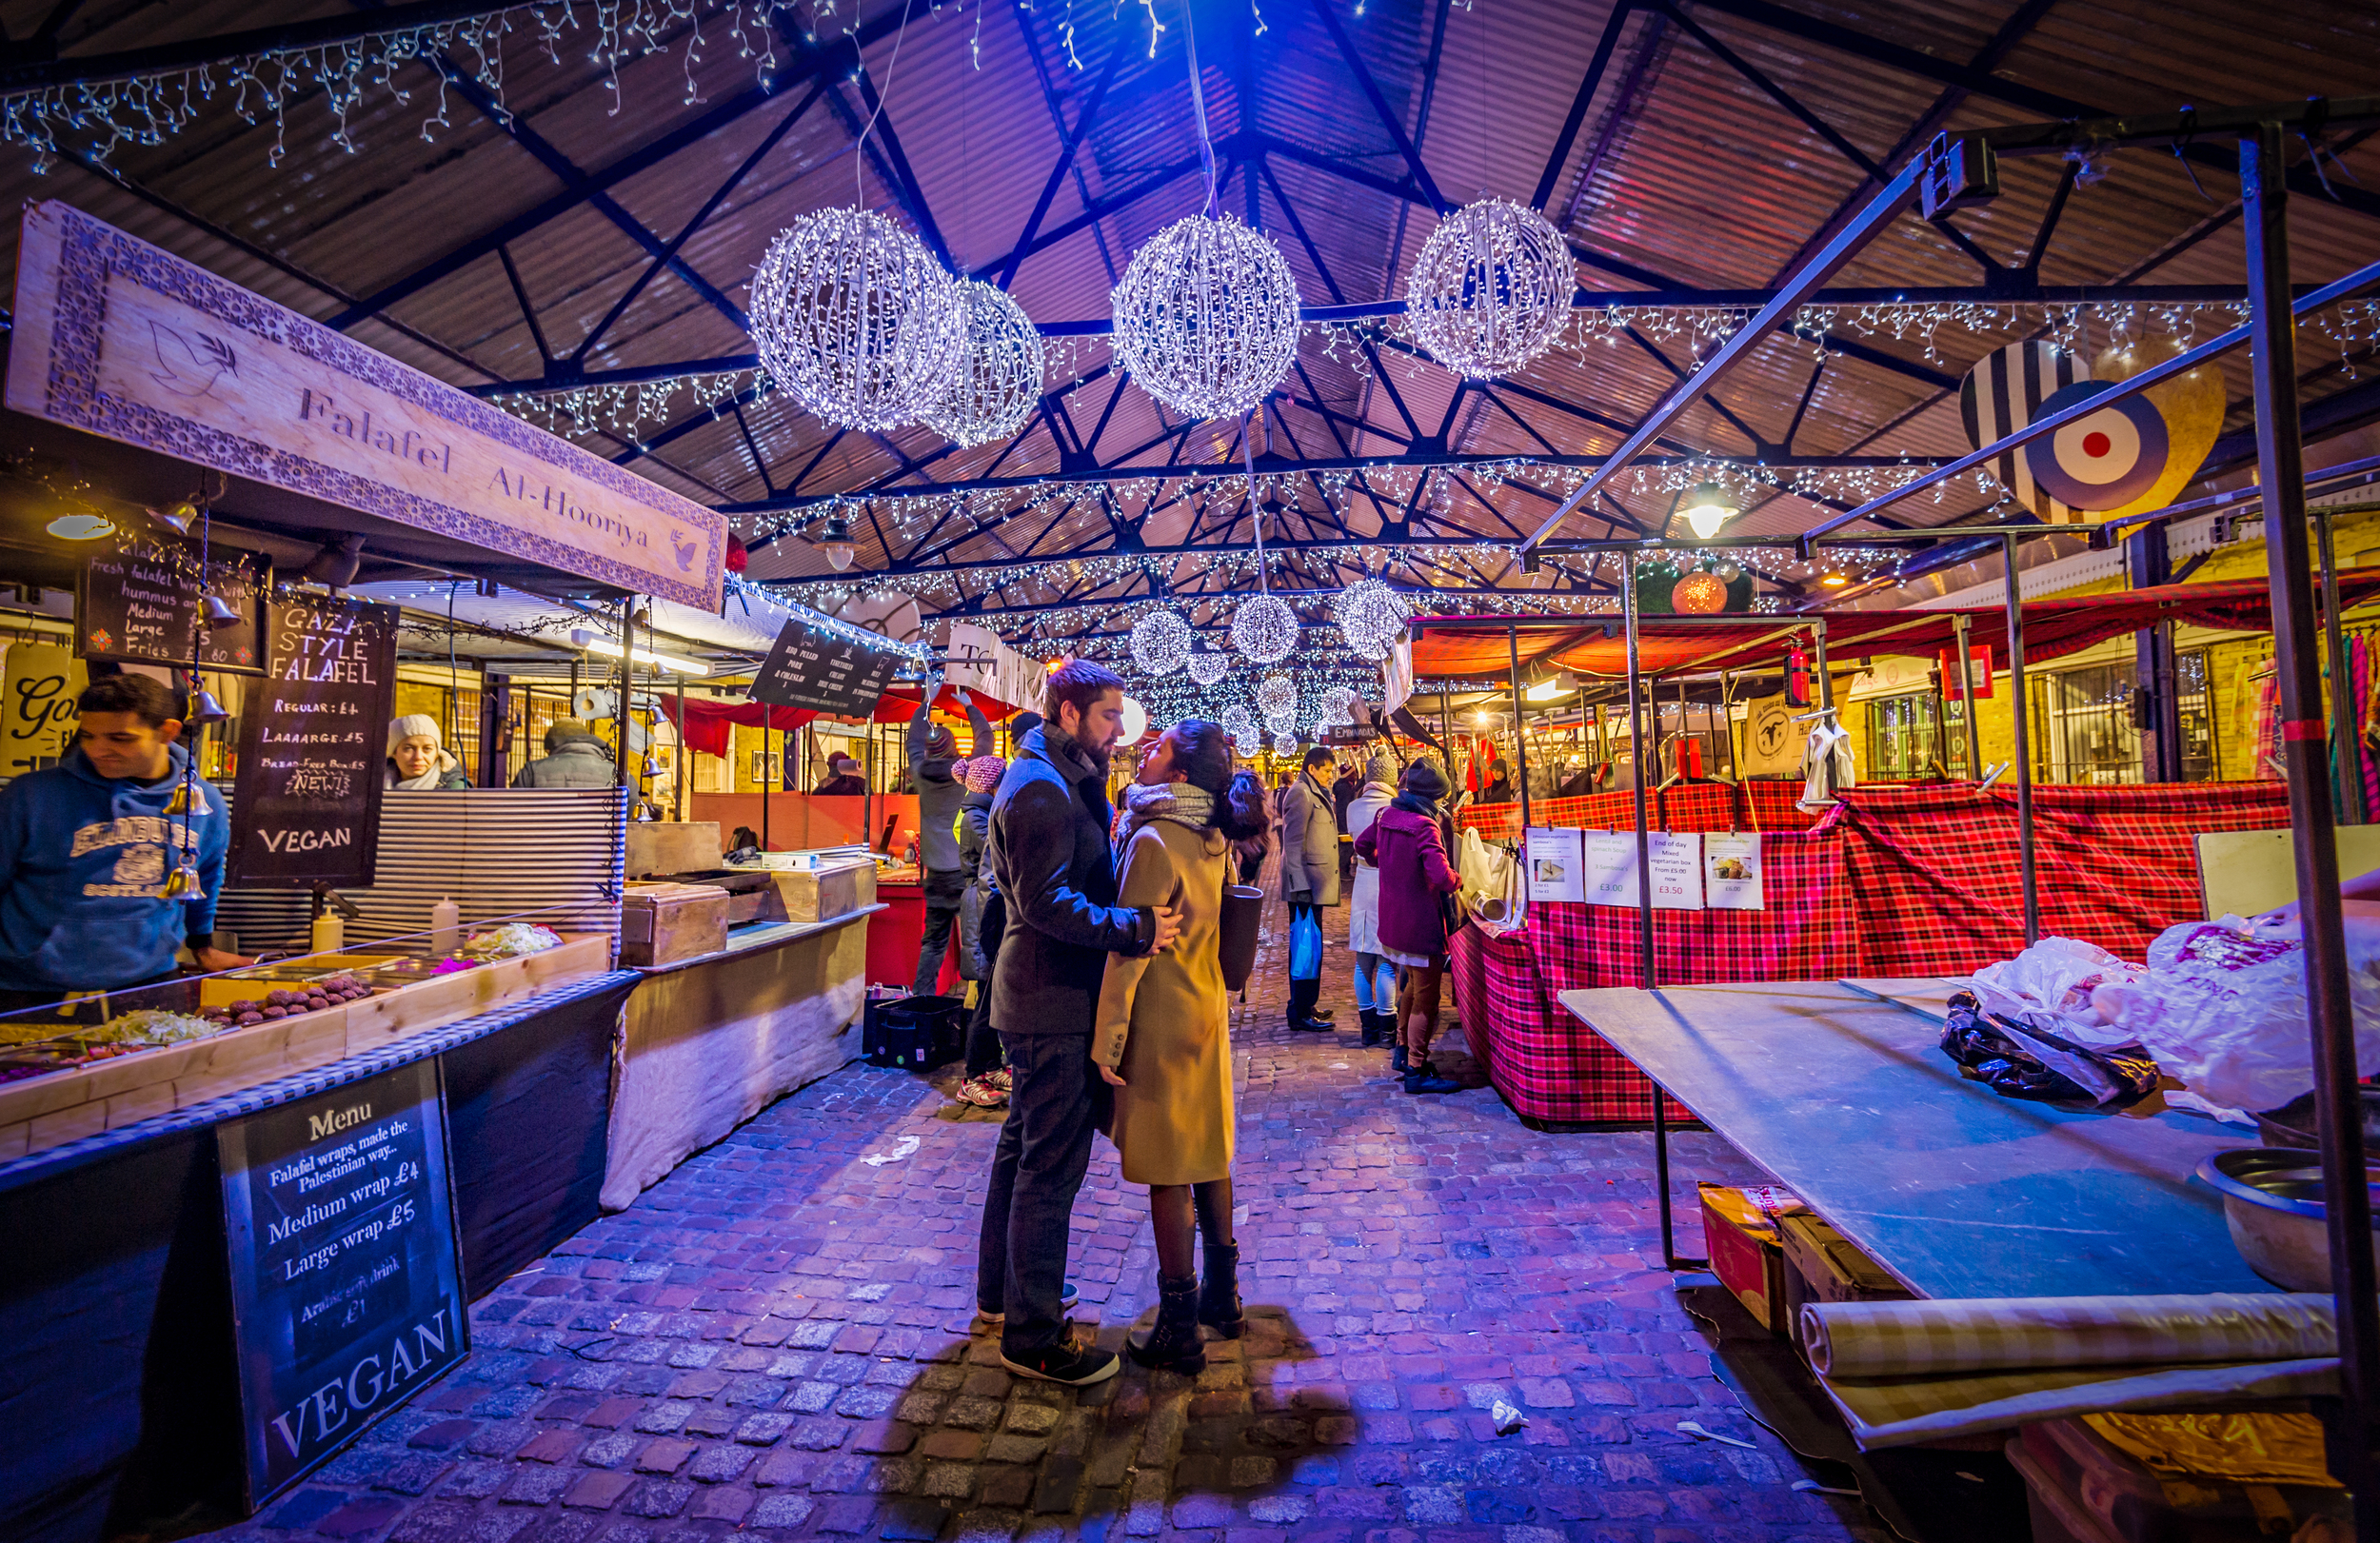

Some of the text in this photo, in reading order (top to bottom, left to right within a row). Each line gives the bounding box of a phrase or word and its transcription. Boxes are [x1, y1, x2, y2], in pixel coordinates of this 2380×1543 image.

[299, 386, 648, 548] Falafel Al-Hooriya
[90, 557, 125, 575] Fresh
[131, 564, 172, 587] falafel
[121, 580, 198, 610] hummus an
[127, 602, 173, 622] Medium
[125, 619, 165, 643] Large
[125, 636, 169, 658] Fries
[279, 632, 368, 662] STYLE
[270, 657, 377, 685] FALAFEL
[11, 675, 80, 740] Go
[257, 827, 351, 852] VEGAN
[1599, 883, 1623, 892] £3.00
[1659, 885, 1683, 895] £3.50
[308, 1103, 372, 1141] Menu
[269, 1120, 408, 1188] Falafel wraps, made the
[298, 1144, 398, 1194] Palestinian way...
[268, 1160, 420, 1246] Medium wrap £4
[284, 1198, 415, 1280] Large wrap £5
[271, 1309, 448, 1460] VEGAN
